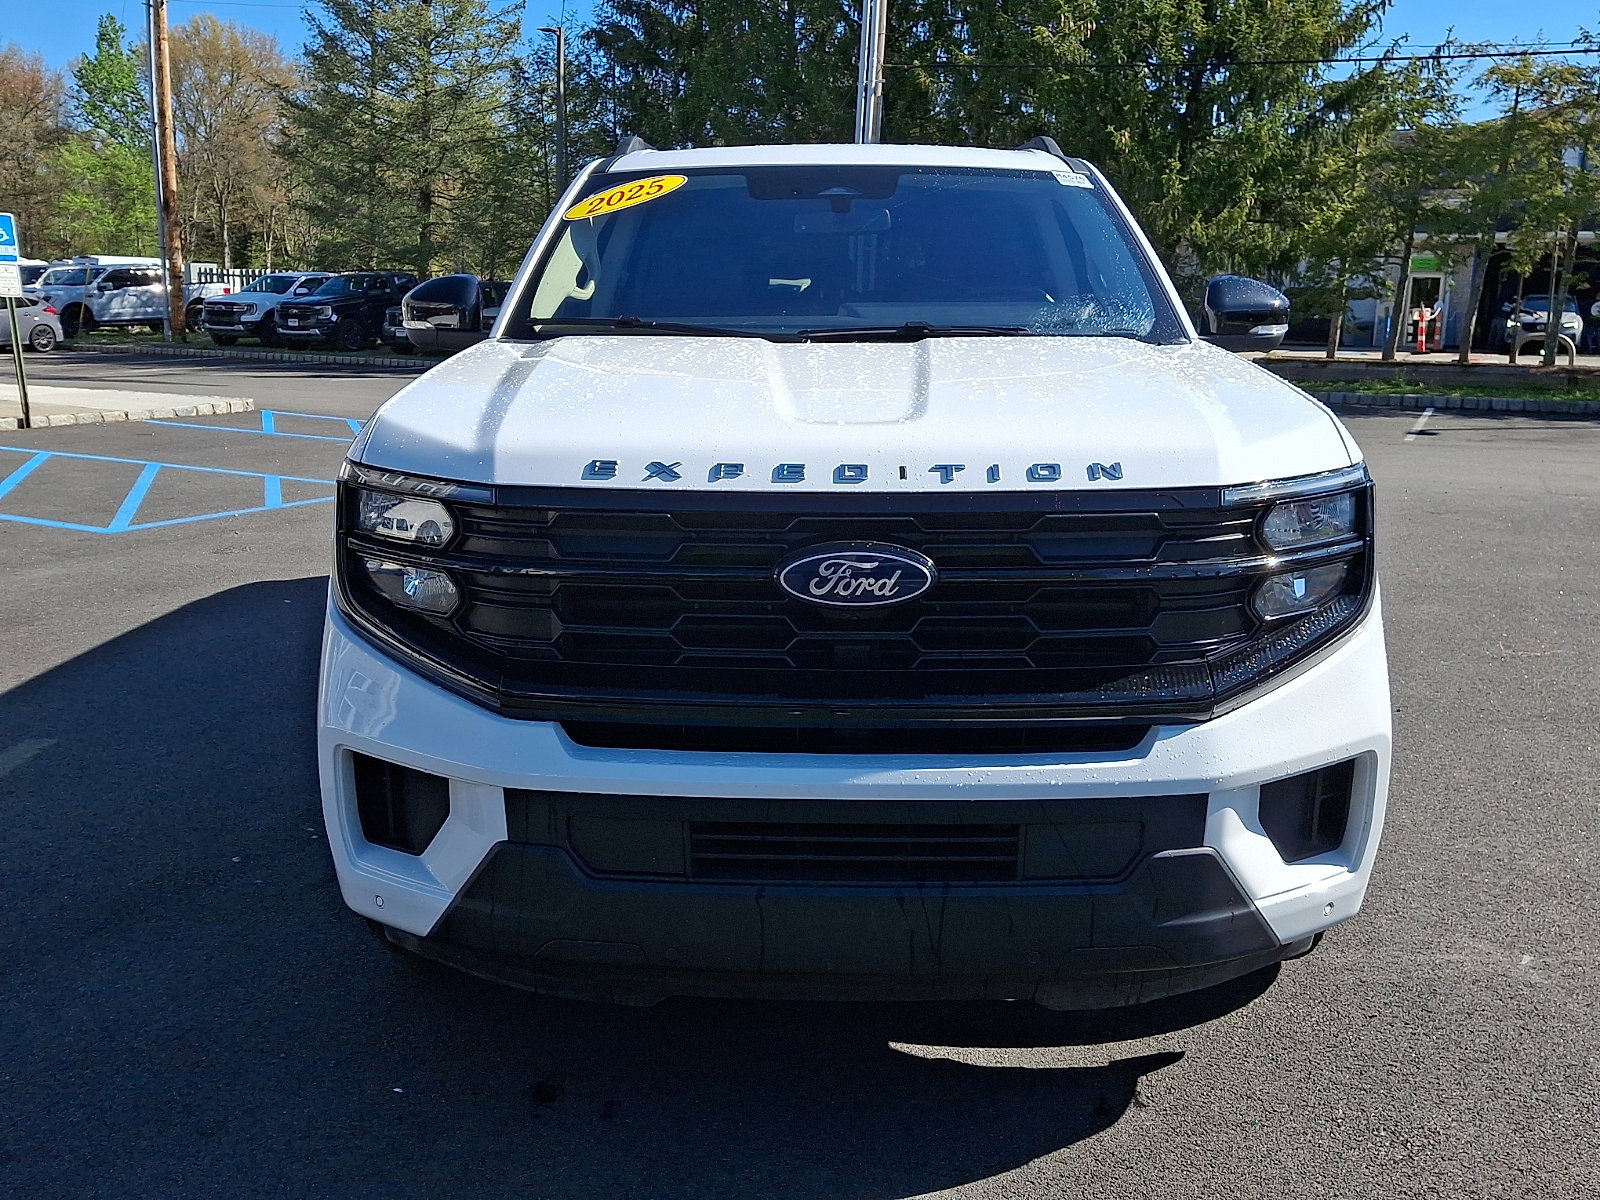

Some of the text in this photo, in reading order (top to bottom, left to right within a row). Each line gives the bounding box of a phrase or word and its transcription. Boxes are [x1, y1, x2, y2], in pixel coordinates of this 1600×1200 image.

[585, 179, 665, 215] 2025
[581, 459, 1124, 484] EXPEDITION
[809, 559, 902, 596] Ford
